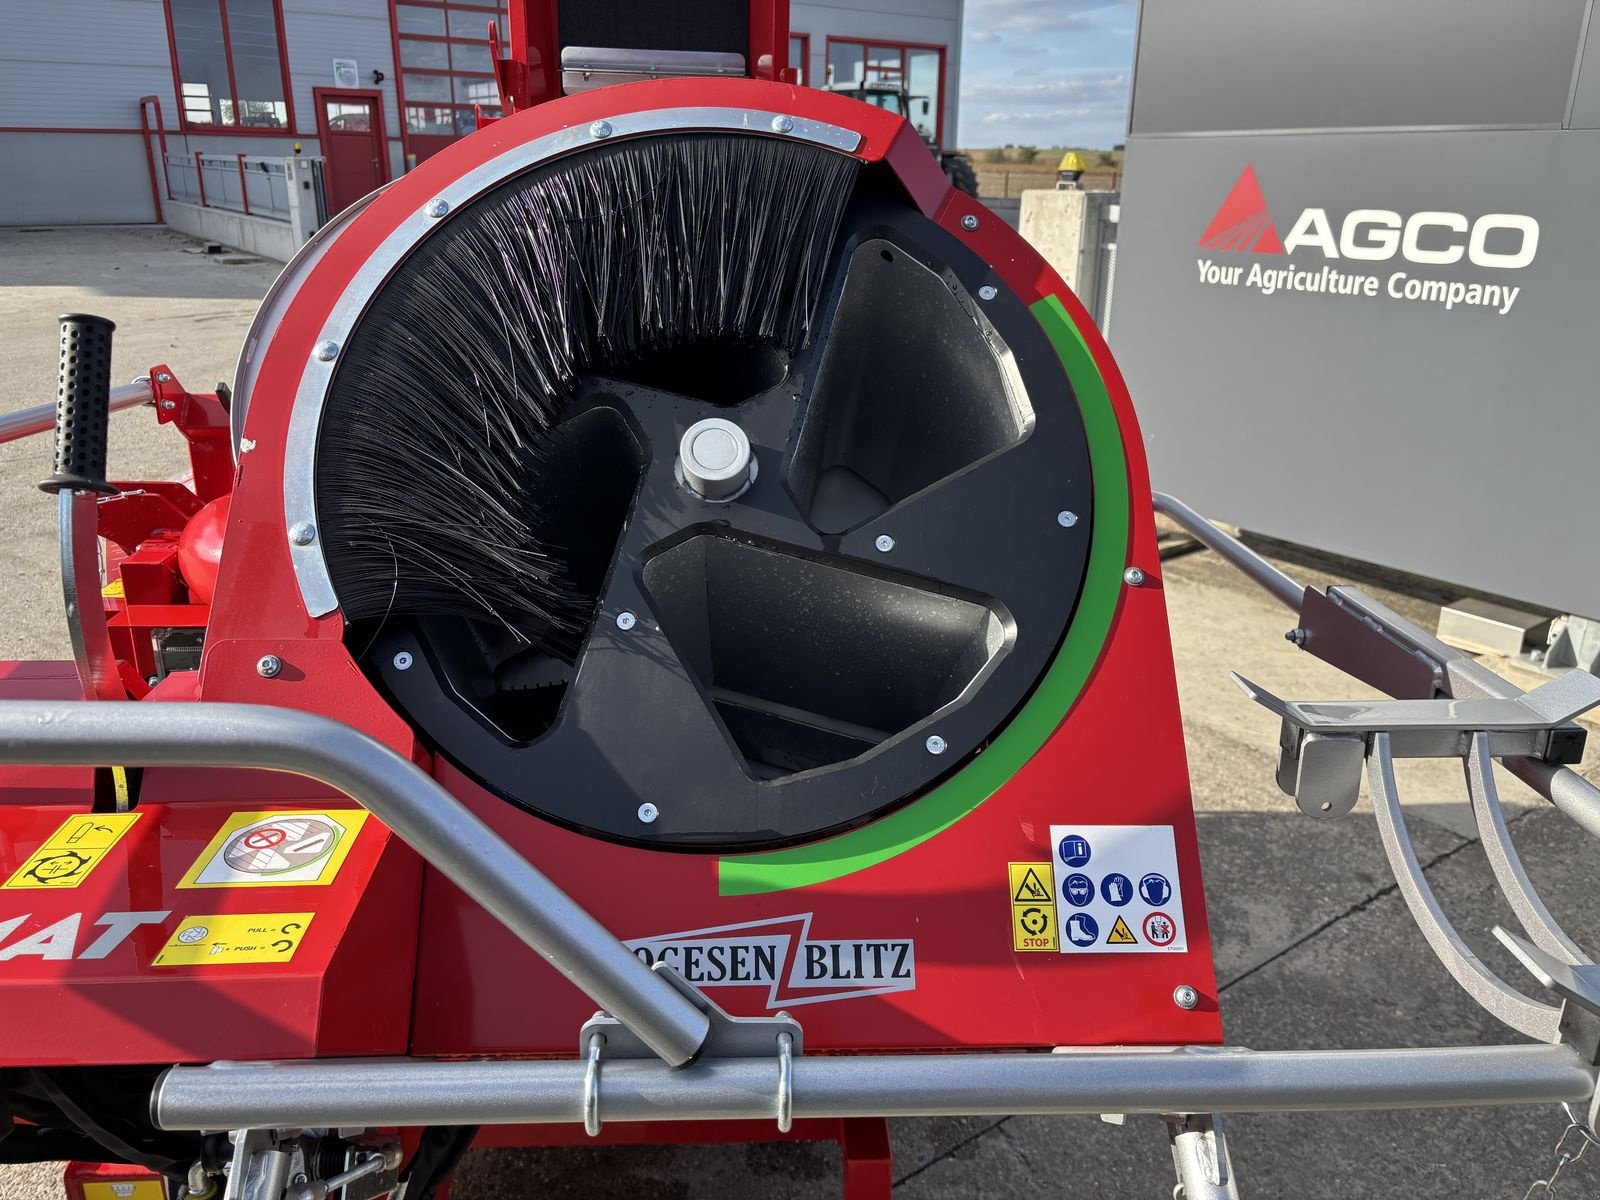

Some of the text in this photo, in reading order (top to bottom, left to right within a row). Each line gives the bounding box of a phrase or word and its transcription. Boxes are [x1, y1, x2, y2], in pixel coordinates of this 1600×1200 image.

[1284, 208, 1540, 269] AGCO
[1197, 259, 1520, 315] Your Agriculture Company
[633, 943, 911, 982] OGESEN BLITZ
[1023, 937, 1049, 947] STOP
